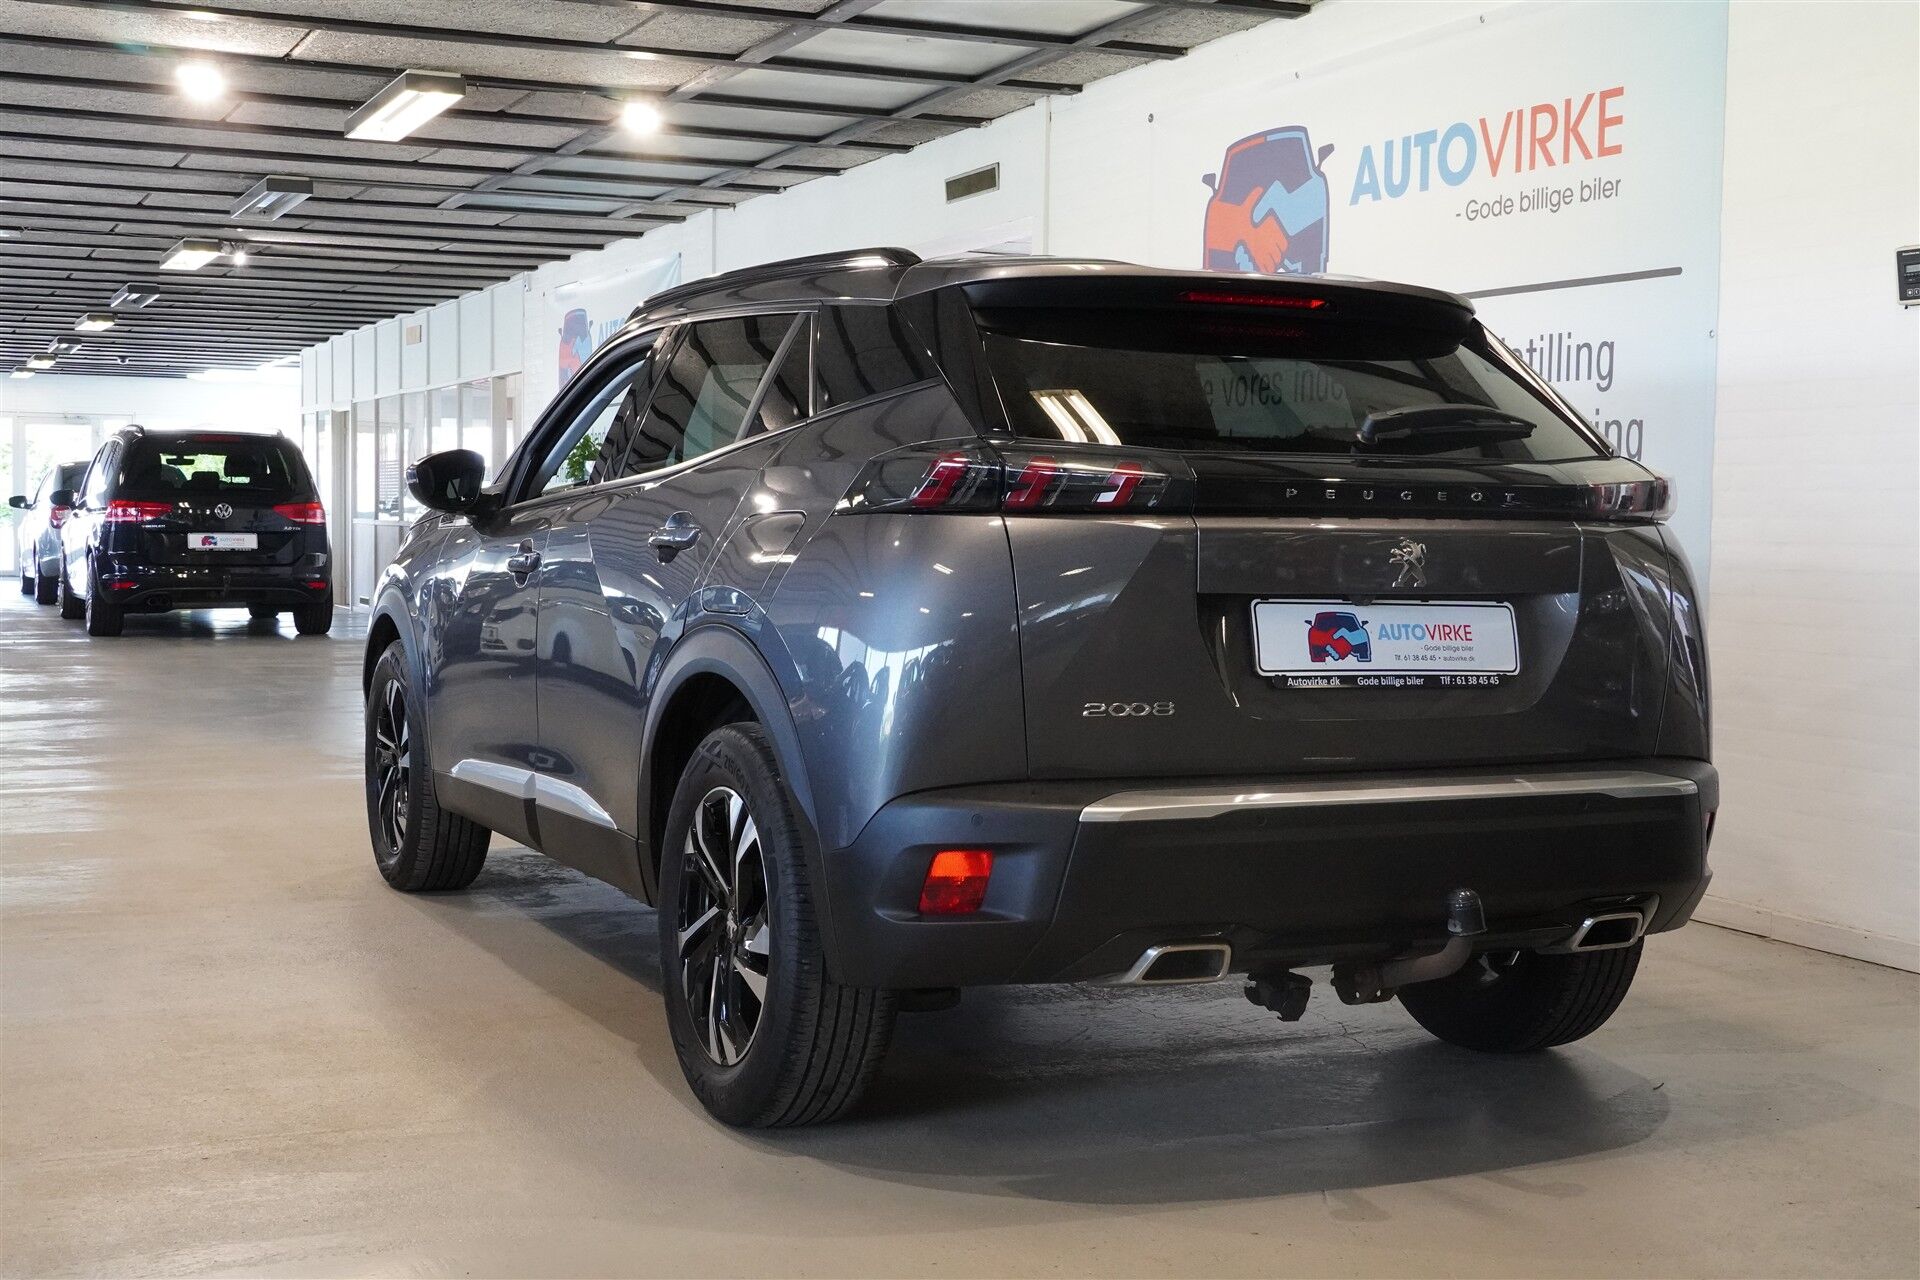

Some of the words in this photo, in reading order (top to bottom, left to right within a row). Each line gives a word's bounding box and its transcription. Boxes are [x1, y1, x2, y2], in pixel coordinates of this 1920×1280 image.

[1349, 86, 1624, 206] AUTOVIRKE
[1465, 198, 1514, 221] Gode
[1519, 186, 1573, 213] billige
[1580, 177, 1622, 202] biler
[1501, 332, 1615, 392] tilling
[1222, 372, 1283, 407] vores
[1286, 488, 1515, 502] PEUGEOT
[1378, 623, 1473, 641] AUTOVIRKE
[1424, 644, 1441, 652] Gode
[1357, 677, 1379, 685] Gode
[1380, 677, 1405, 687] billige
[1406, 677, 1424, 686] biler
[1456, 676, 1466, 685] 61
[1468, 676, 1478, 685] 38
[1478, 676, 1488, 685] 45
[1489, 676, 1499, 685] 45
[1082, 702, 1175, 716] 2008
